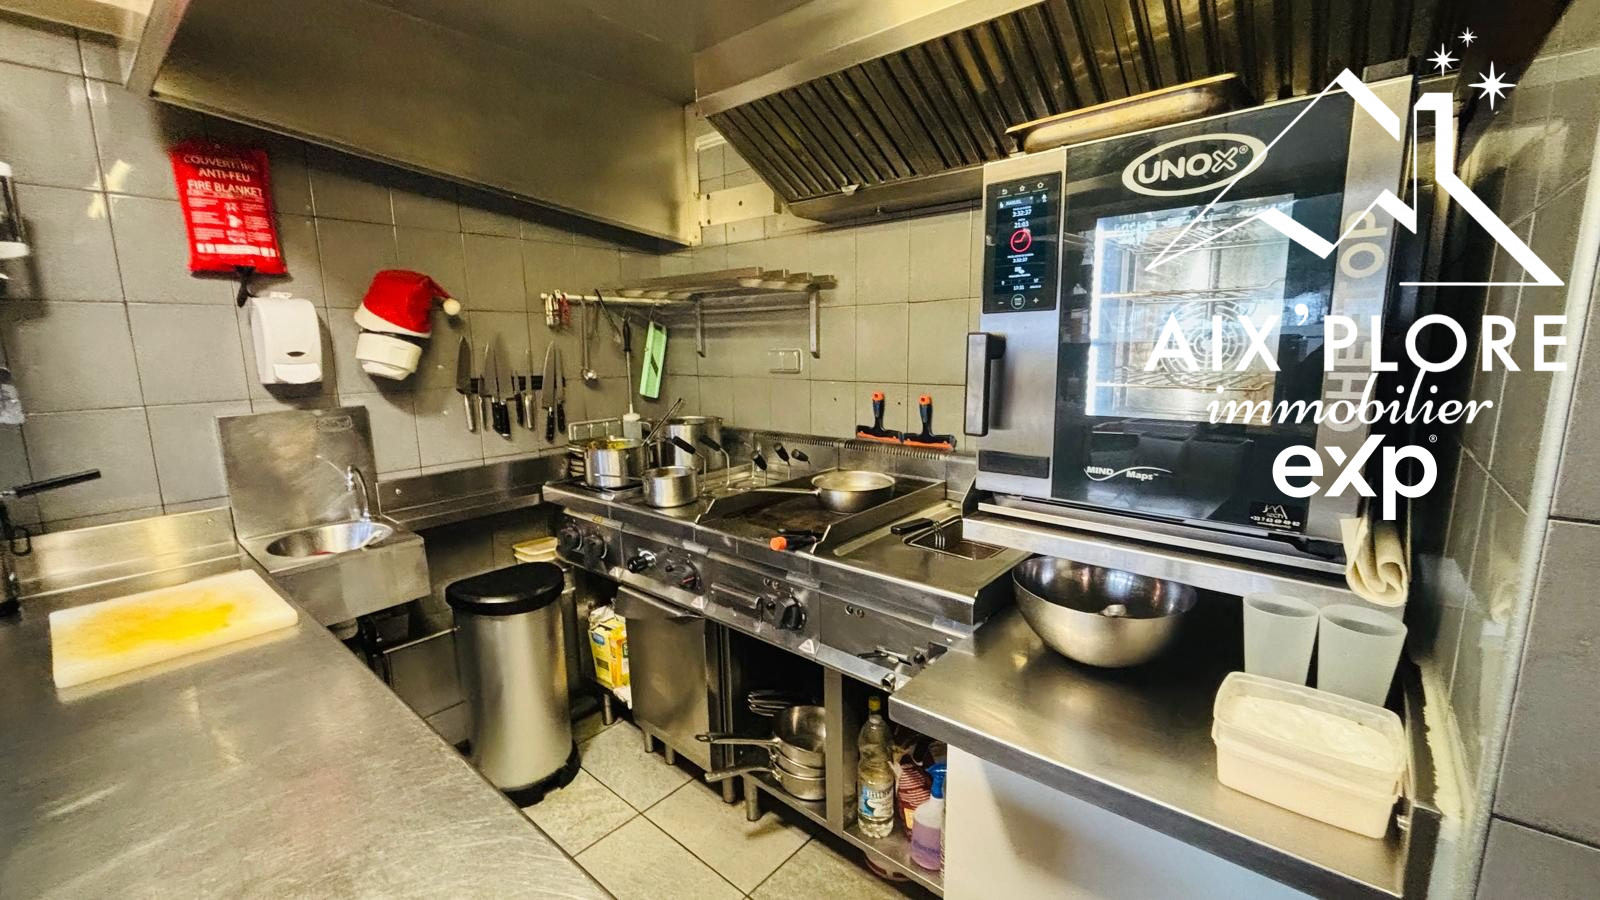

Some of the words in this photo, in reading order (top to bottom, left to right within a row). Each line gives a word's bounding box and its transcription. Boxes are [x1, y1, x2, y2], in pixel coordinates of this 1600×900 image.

[1138, 146, 1239, 184] UNOX
[199, 168, 250, 183] ANTI-FEU
[187, 179, 212, 192] FIRE
[214, 182, 262, 199] BLANKET
[1086, 465, 1115, 476] MIND
[1126, 470, 1154, 482] Maps
